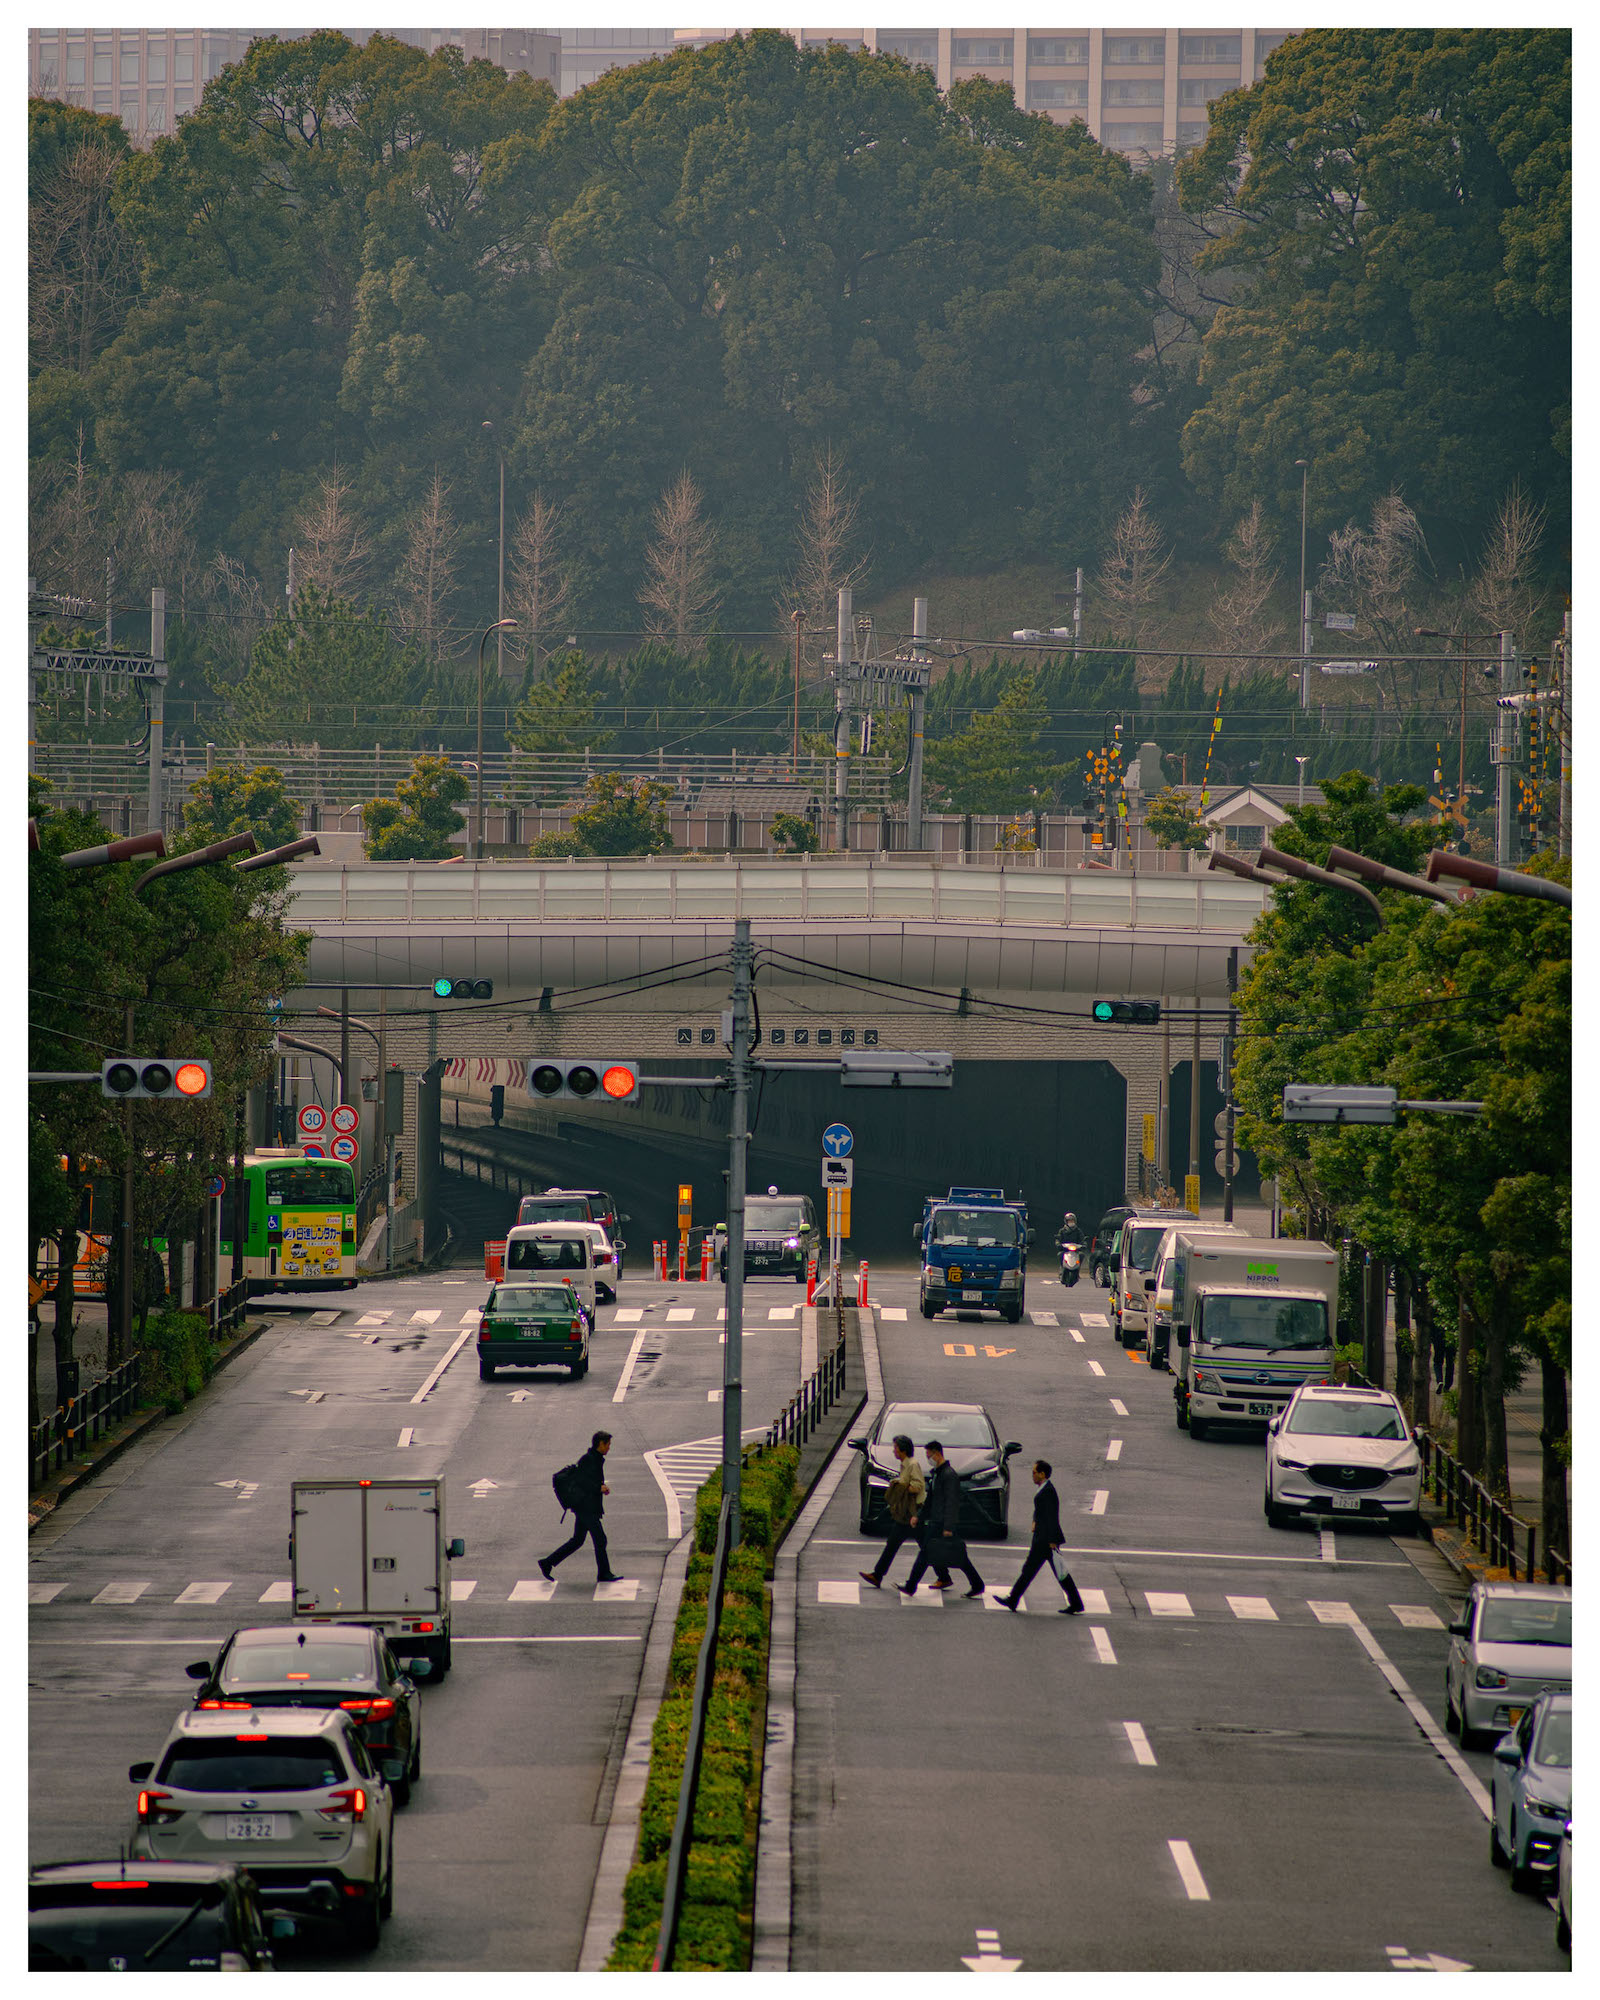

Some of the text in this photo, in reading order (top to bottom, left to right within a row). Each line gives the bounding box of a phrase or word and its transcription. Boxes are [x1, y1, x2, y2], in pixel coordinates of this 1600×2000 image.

[305, 1113, 321, 1126] 30
[947, 1266, 963, 1283] 危
[943, 1343, 1017, 1358] 40
[237, 1823, 271, 1837] 28-22
